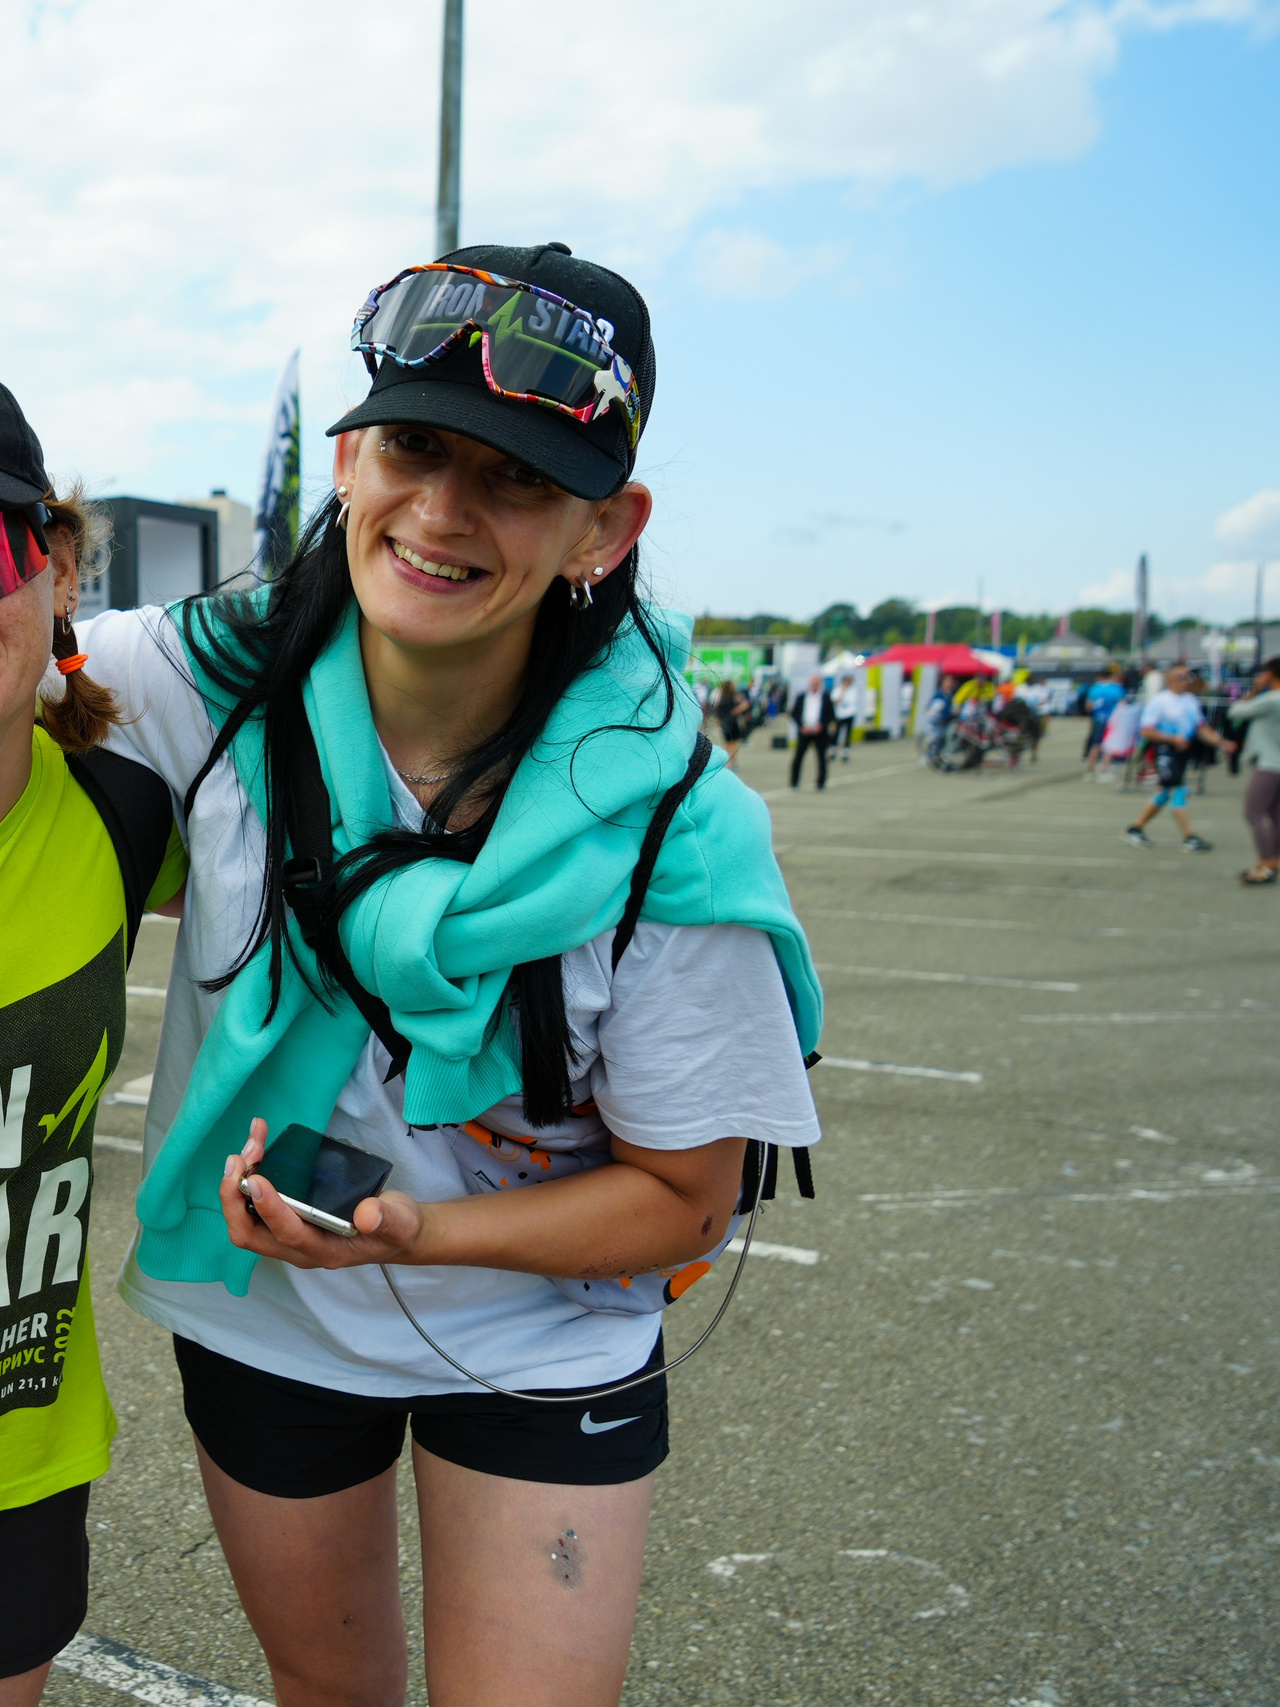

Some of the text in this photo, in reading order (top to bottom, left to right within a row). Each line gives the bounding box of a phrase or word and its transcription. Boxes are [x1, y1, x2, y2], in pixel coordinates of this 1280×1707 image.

[424, 282, 615, 361] IRON STAR
[18, 1377, 46, 1390] 21,1
[52, 1372, 63, 1387] k
